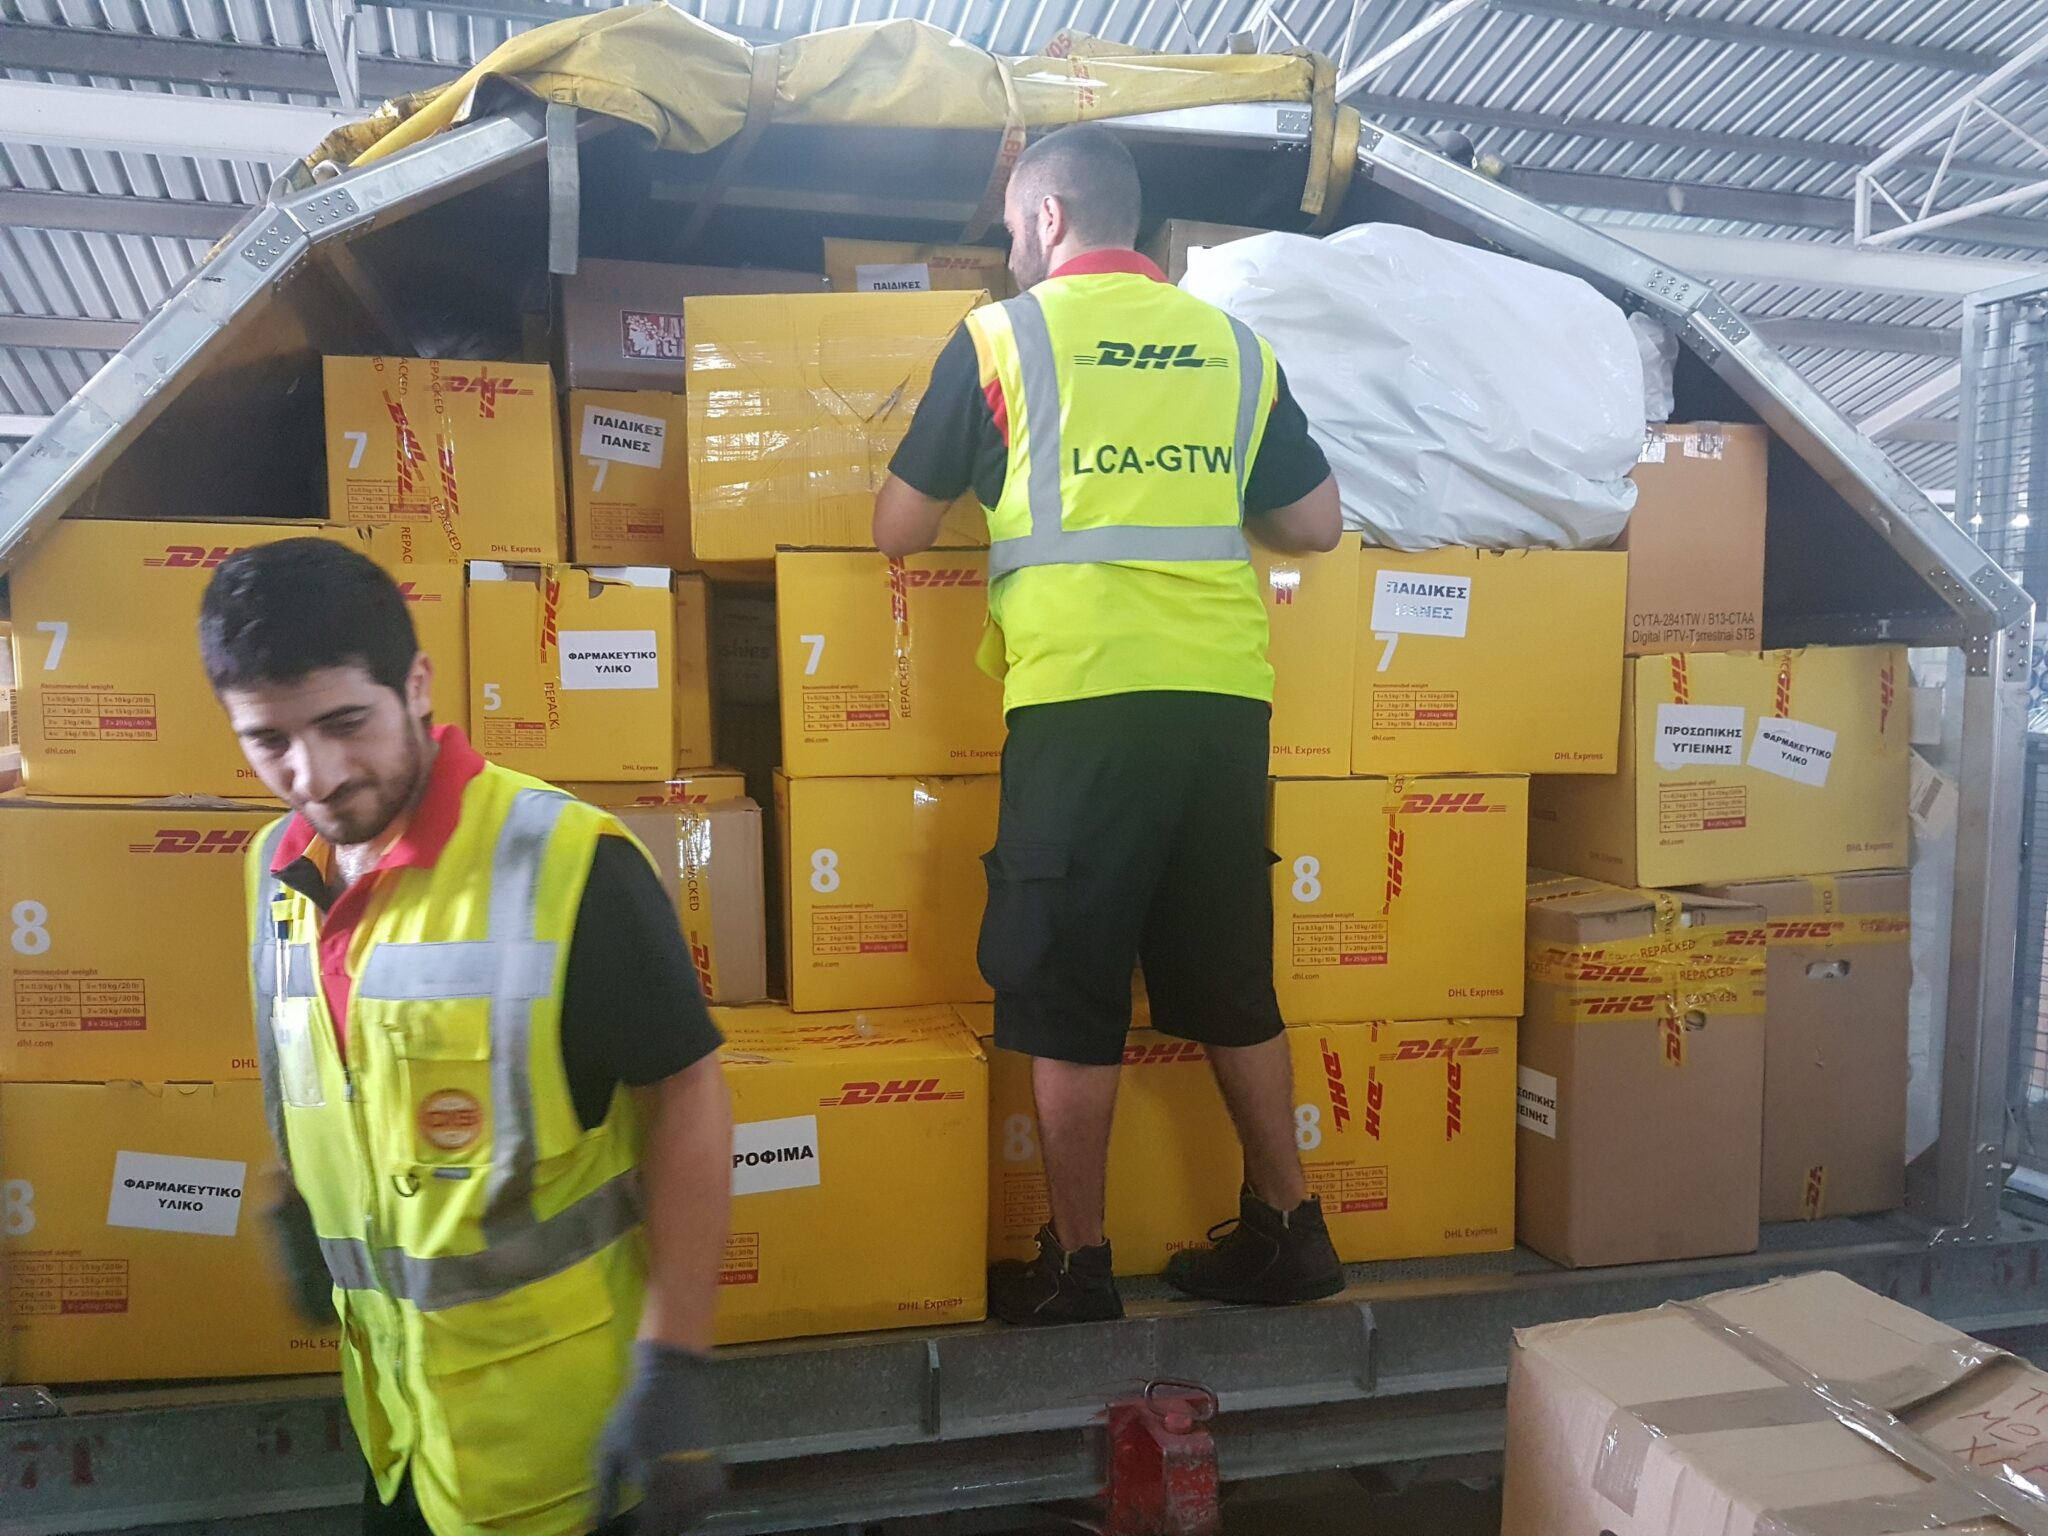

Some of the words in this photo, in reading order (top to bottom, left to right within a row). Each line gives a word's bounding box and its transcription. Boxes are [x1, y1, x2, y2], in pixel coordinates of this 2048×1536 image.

[873, 281, 922, 290] ΠΑΙΔΙΚΕΣ
[1096, 341, 1206, 370] DHL
[430, 360, 444, 415] EPACKED
[593, 414, 663, 437] ΠΑΙΔΙΚΕΣ
[344, 432, 367, 469] 7
[601, 433, 651, 453] ΠΑΝΕΣ
[1073, 444, 1232, 475] LCA-GTW
[587, 459, 609, 492] 7
[431, 496, 462, 552] REPACKED
[164, 546, 239, 567] DH
[402, 526, 413, 565] REPAC
[491, 544, 507, 553] DHL
[510, 545, 541, 554] Express
[905, 569, 982, 587] DHL
[1386, 581, 1467, 599] ΠΑΙΔΙΚΕΣ
[541, 578, 560, 650] DHL
[1634, 613, 1700, 627] CYTA-2841TW
[1708, 612, 1754, 625] B13-CTAA
[36, 622, 69, 670] 7
[1632, 629, 1660, 646] Digital
[1736, 628, 1755, 641] STB
[568, 651, 657, 660] ΦΑΡΜΑΚΕΥΤΙΚΟ
[800, 635, 825, 675] 7
[1375, 633, 1399, 672] 7
[595, 665, 632, 673] ΥΛΙΚΟ
[484, 684, 501, 710] 5
[900, 655, 911, 718] REPACKED
[1664, 725, 1742, 739] ΠΡΟΣΩΠΙΚΗΣ
[1272, 746, 1293, 755] DHL
[1295, 746, 1331, 756] Express
[1672, 743, 1732, 755] ΥΓΙΕΙΝΗΣ
[1762, 731, 1832, 759] ΦΑΡΜΑΚΕΥΤΙΚΟ
[1554, 752, 1571, 760] DHL
[1574, 752, 1603, 762] Express
[1781, 751, 1807, 766] ΥΛΙΚΟ
[1399, 793, 1490, 813] DHL
[153, 829, 256, 853] DH
[810, 848, 841, 893] 8
[1386, 828, 1405, 902] DHL
[1292, 856, 1321, 903] 8
[11, 900, 51, 955] 8
[1766, 922, 1831, 938] DHL
[1640, 939, 1696, 957] REPACKED
[1578, 963, 1651, 983] DHL
[1680, 967, 1734, 981] REPACKED
[1448, 988, 1467, 997] DHL
[1470, 988, 1504, 998] Express
[1583, 994, 1656, 1015] DHL
[1122, 1042, 1206, 1066] DHL
[1397, 1036, 1482, 1060] DHL
[232, 1059, 258, 1069] DHL
[839, 1079, 946, 1106] DHL
[1322, 1051, 1351, 1132] DHL
[1446, 1062, 1462, 1140] DHL
[1294, 1104, 1322, 1150] 8
[1004, 1114, 1034, 1163] 8
[732, 1145, 814, 1169] ΡΟΦΙΜΑ
[123, 1178, 241, 1199] ΦΑΡΜΑΚΕΥΤΙΚΟ
[158, 1198, 203, 1212] ΥΛΙΚΟ
[1444, 1229, 1462, 1239] DHL
[1465, 1226, 1498, 1239] Express
[898, 1302, 919, 1311] DHL
[924, 1297, 963, 1310] Express
[290, 1339, 316, 1349] DHL
